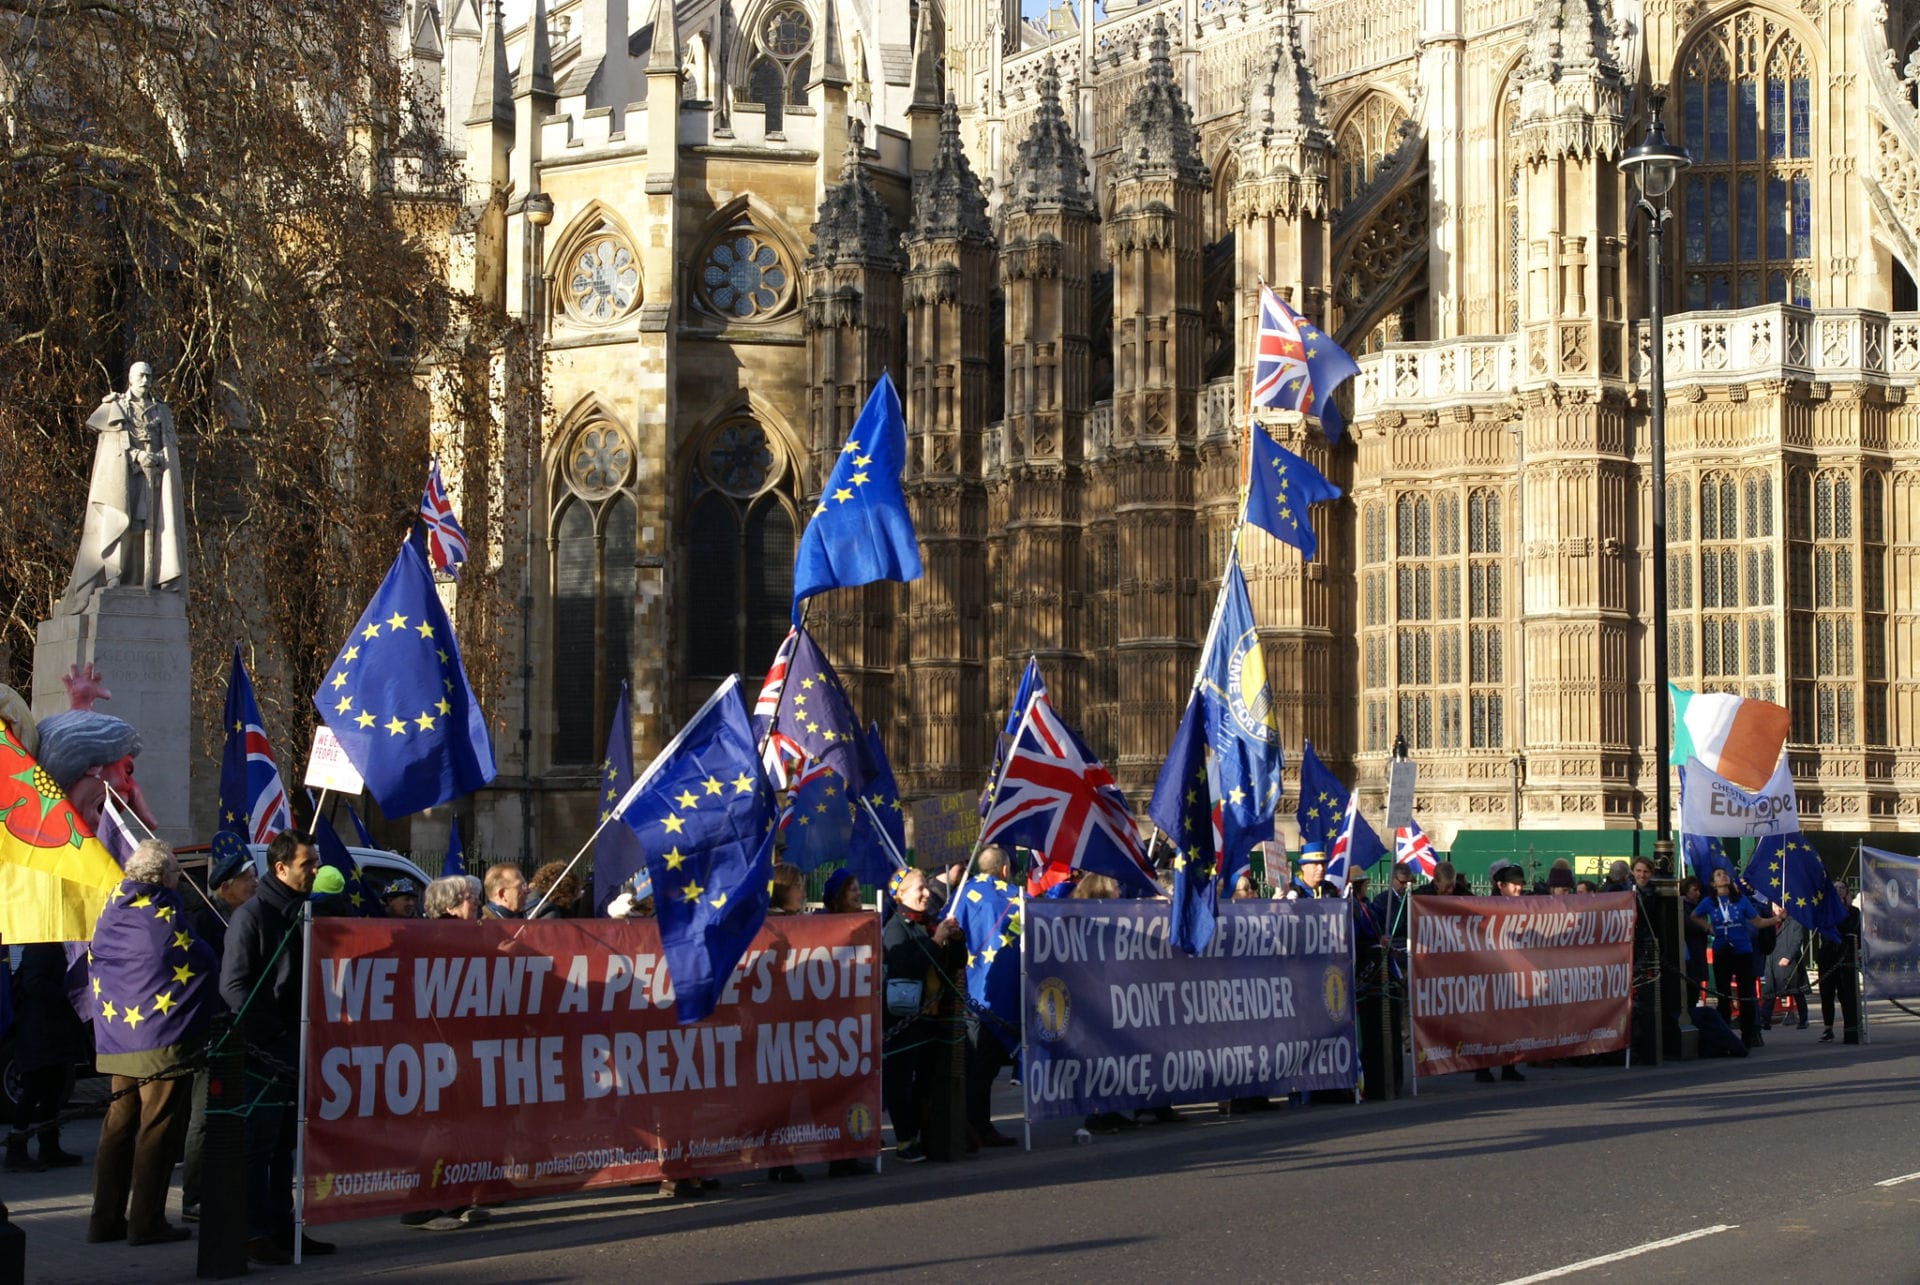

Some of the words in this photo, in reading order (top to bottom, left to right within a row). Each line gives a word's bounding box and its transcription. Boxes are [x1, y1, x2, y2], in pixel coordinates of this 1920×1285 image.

[1229, 650, 1246, 694] TIME
[1232, 698, 1256, 732] FOR
[958, 808, 977, 828] THE
[1710, 792, 1793, 820] Europe
[1033, 916, 1109, 964] DON'T
[1115, 916, 1174, 961] BACK
[1231, 914, 1299, 958] BREXIT
[1305, 913, 1348, 955] DEAL
[1416, 915, 1466, 955] MAKE
[1466, 915, 1484, 952] IT
[1485, 914, 1496, 951] A
[1499, 911, 1596, 950] MEANINGFUL
[1601, 909, 1633, 943] VOTE
[320, 957, 398, 1023] WE
[414, 955, 554, 1019] WANT
[558, 955, 588, 1014] A
[601, 949, 776, 1011] PEOE'S
[785, 945, 872, 1001] VOTE
[1110, 981, 1177, 1029] DON'T
[1181, 976, 1296, 1025] SURRENDER
[1416, 973, 1489, 1017] HISTORY
[1492, 971, 1529, 1011] WILL
[1531, 965, 1602, 1008] REMEMBER
[1605, 963, 1630, 998] YOU
[319, 1042, 457, 1121] STOP
[472, 1036, 566, 1108] THE
[581, 1026, 742, 1100] BREXIT
[757, 1014, 872, 1085] MESS!
[1031, 1059, 1082, 1104] OUR
[1085, 1052, 1158, 1101] VOICE,
[1163, 1050, 1206, 1093] OUR
[1206, 1046, 1255, 1088] VOTE
[1258, 1045, 1272, 1082] &
[1275, 1041, 1309, 1081] OUR
[1308, 1036, 1350, 1075] VETO
[335, 1170, 421, 1196] SODEMAction
[443, 1160, 529, 1185] SODEMLondon
[770, 1122, 841, 1146] #SODEMAction
